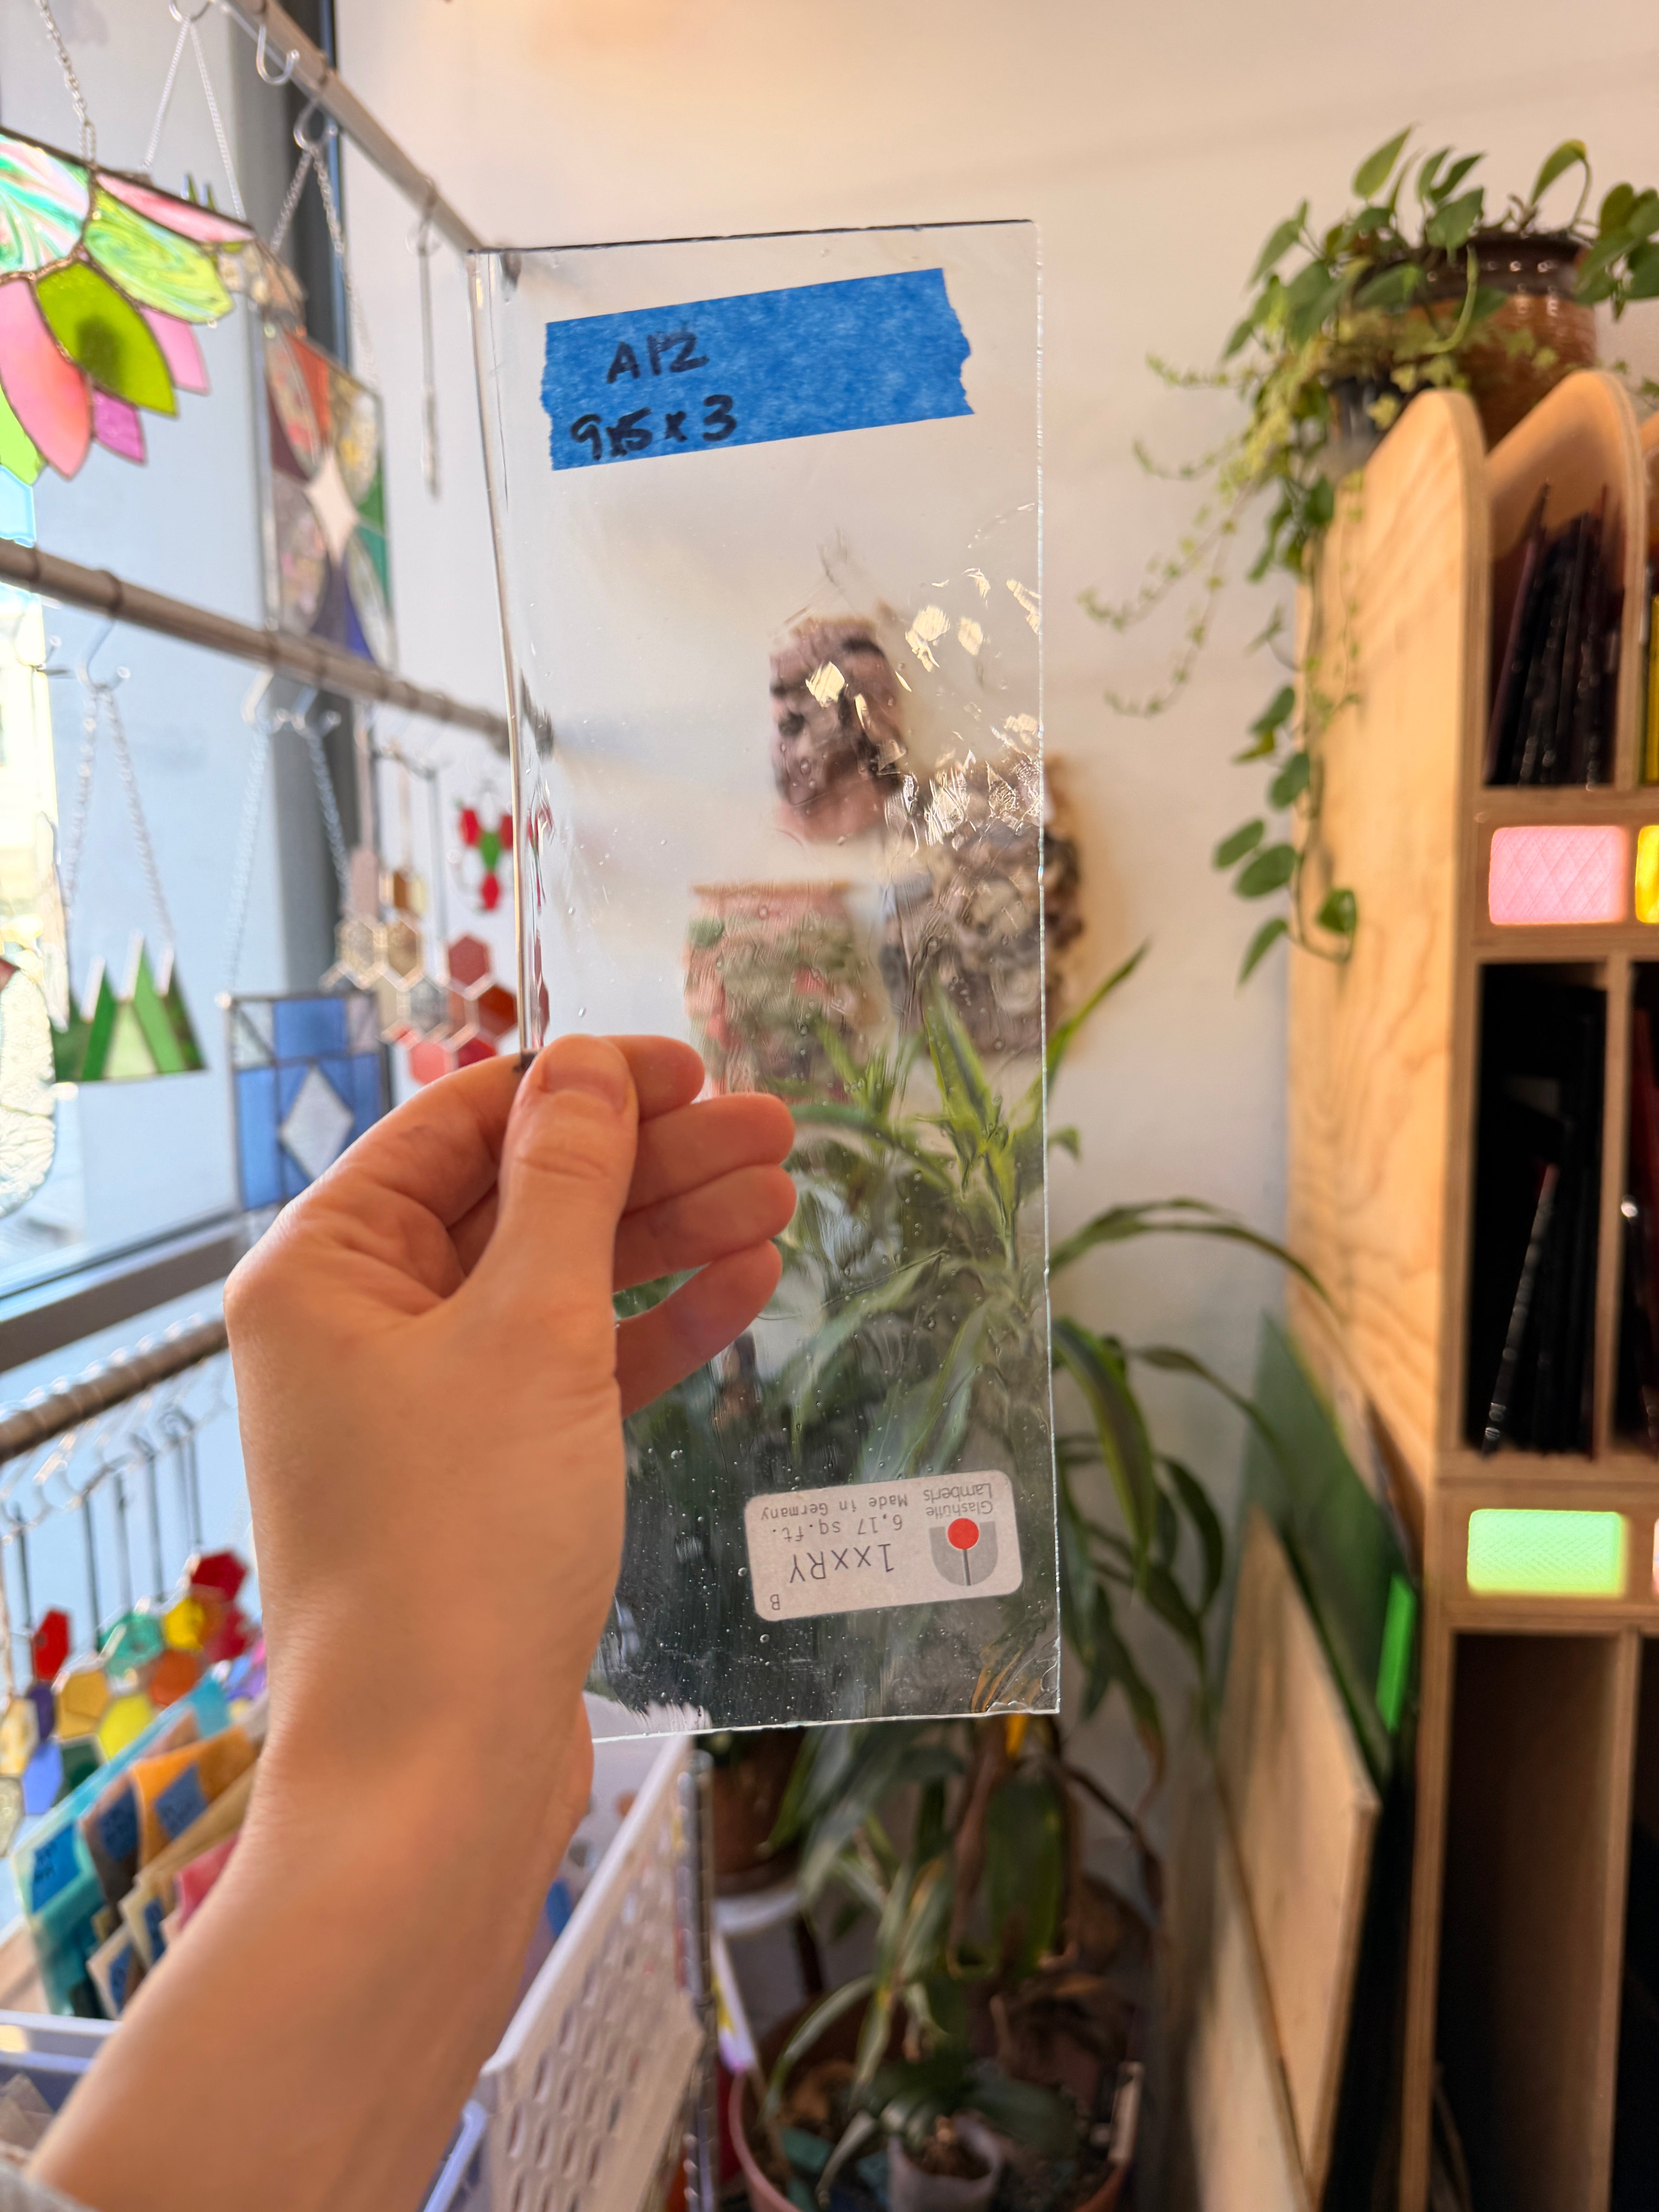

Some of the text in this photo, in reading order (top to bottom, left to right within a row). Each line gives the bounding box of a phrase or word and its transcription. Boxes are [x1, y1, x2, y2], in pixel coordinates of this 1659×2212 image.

[702, 394, 737, 442] 3
[923, 1482, 992, 1501] Lamberts
[761, 1495, 908, 1520] Made in Germany
[925, 1500, 994, 1518] Glashütte
[789, 1544, 895, 1583] 1xxRY
[769, 1594, 781, 1610] B
